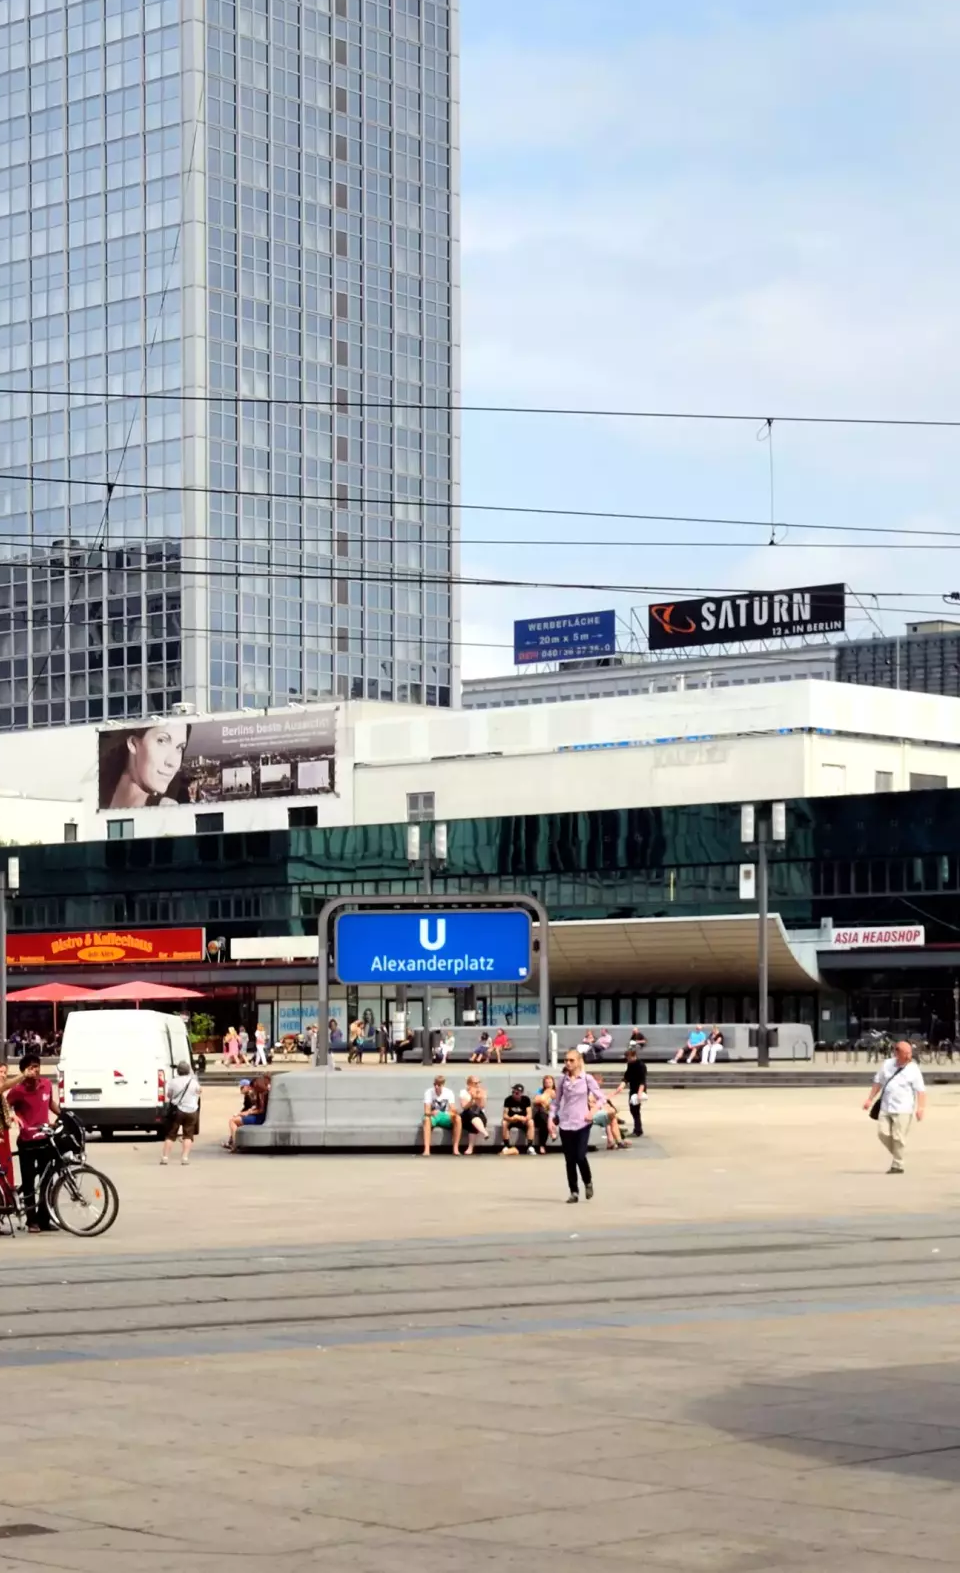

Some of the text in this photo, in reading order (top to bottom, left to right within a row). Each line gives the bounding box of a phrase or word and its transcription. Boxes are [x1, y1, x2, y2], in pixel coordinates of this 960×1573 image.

[701, 593, 811, 631] SATURN
[772, 627, 781, 636] 12
[793, 624, 804, 633] IN
[807, 621, 841, 632] BERLIN
[222, 725, 254, 736] Berlins
[419, 918, 446, 951] U
[834, 930, 920, 944] ASIA HEADSHOP
[51, 935, 83, 954] Bistro
[370, 954, 494, 975] Alexanderplatz
